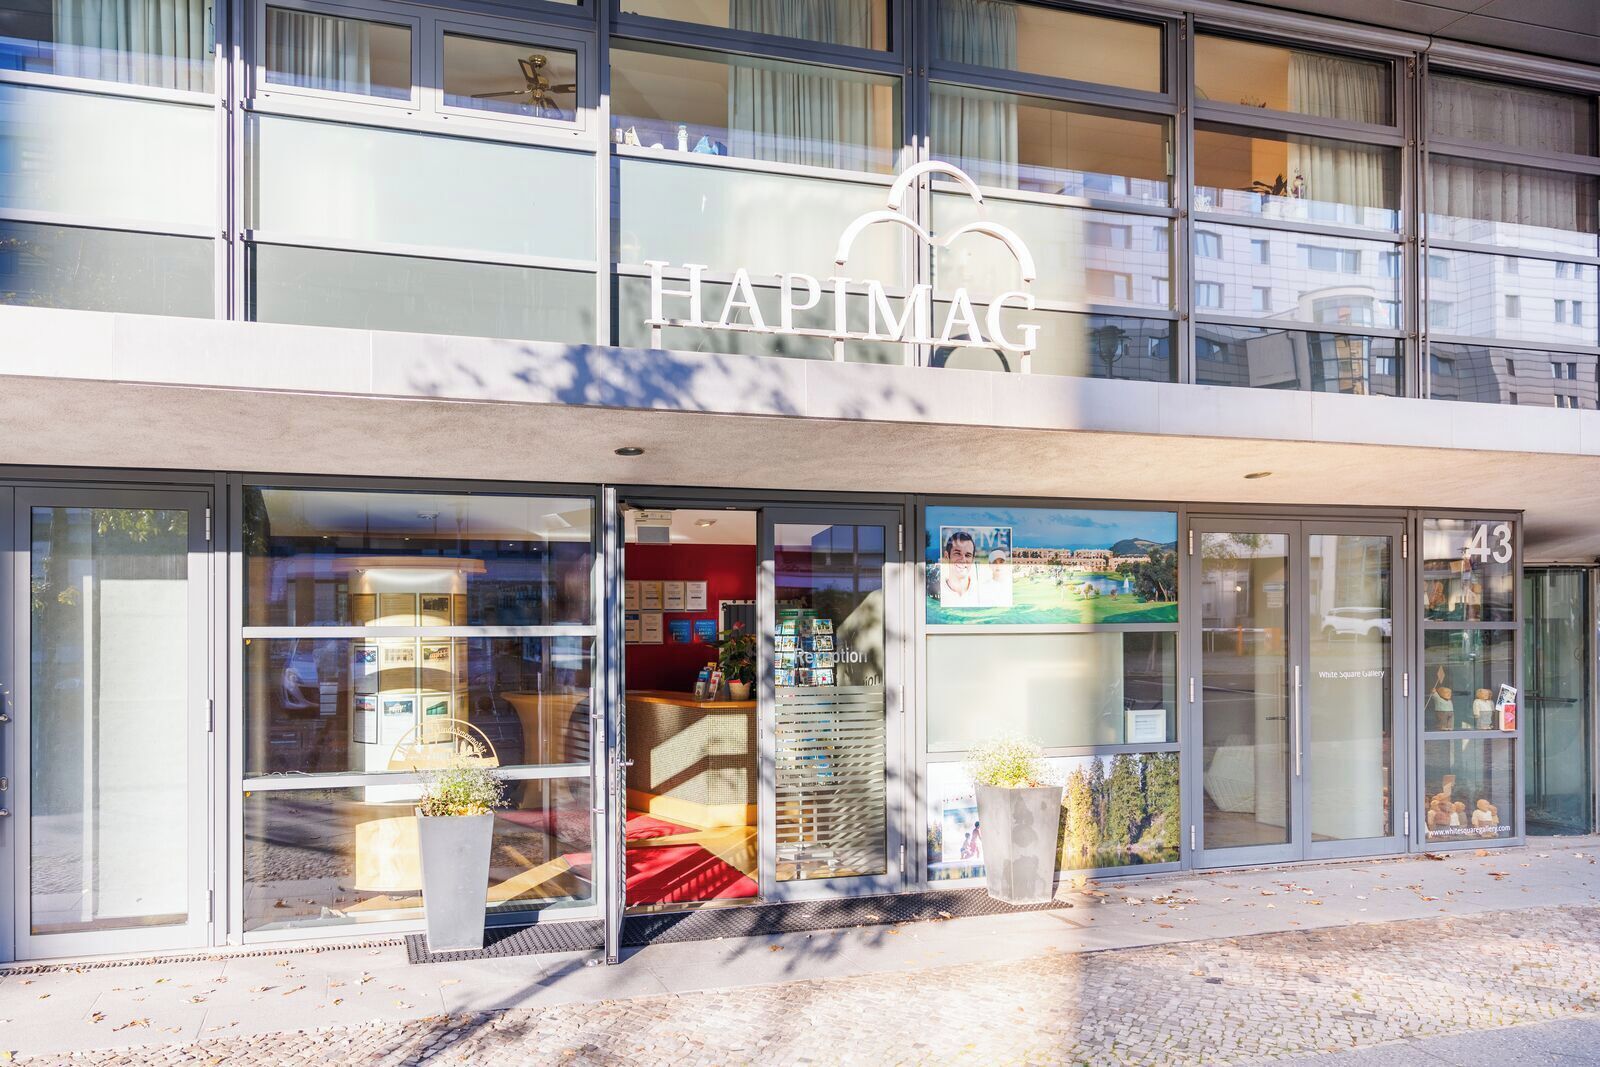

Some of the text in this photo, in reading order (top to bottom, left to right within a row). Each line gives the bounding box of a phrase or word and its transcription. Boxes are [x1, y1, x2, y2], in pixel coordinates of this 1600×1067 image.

[644, 260, 1040, 352] HAPIMAG
[943, 528, 1008, 548] ATIVE
[1468, 524, 1513, 564] 43
[1340, 671, 1361, 679] Square
[1362, 670, 1384, 678] Gallery
[1429, 825, 1511, 836] www.whitesquaregallery.com
